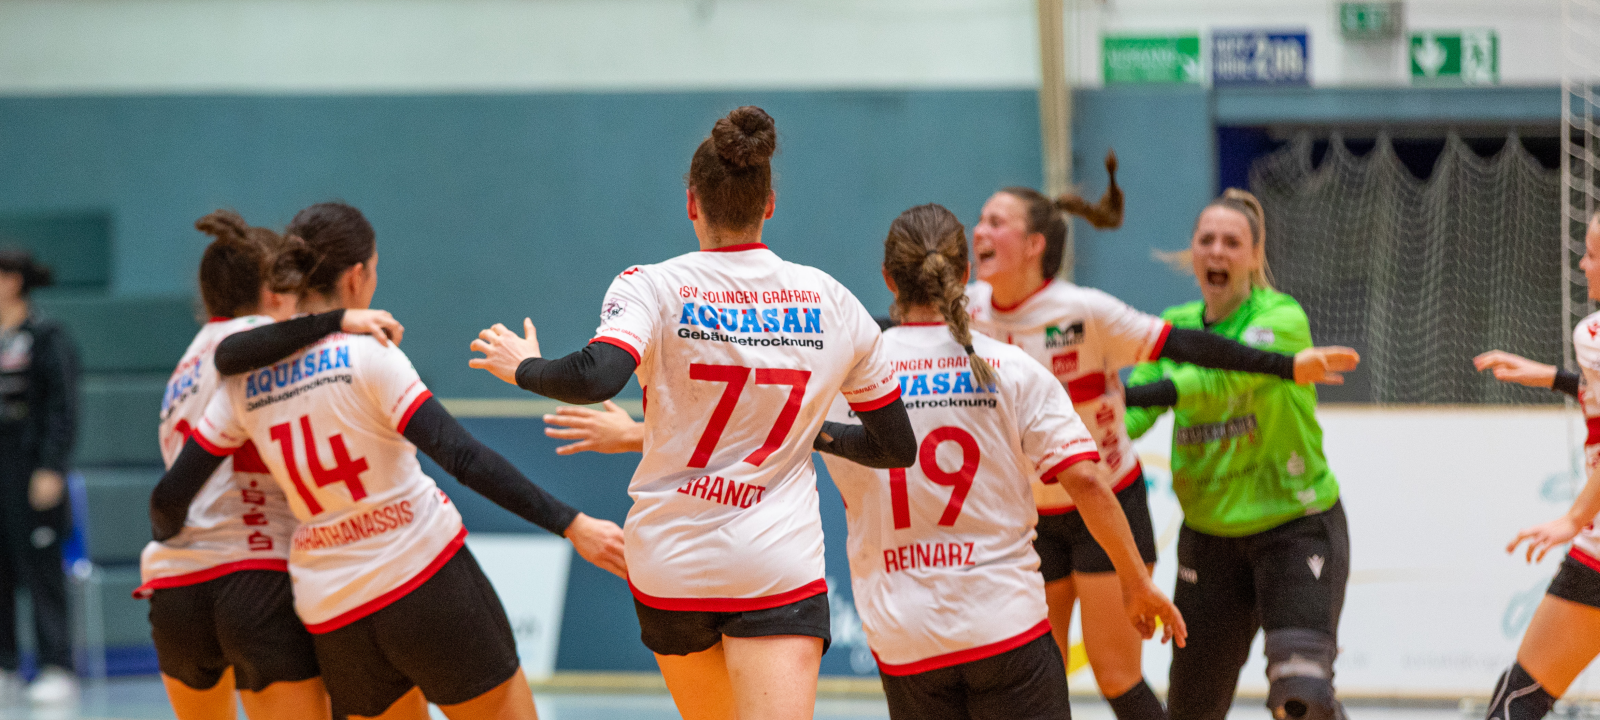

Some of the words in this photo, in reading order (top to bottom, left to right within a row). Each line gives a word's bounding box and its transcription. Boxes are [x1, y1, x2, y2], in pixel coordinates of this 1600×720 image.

[677, 328, 824, 350] Gebäudetrocknung
[269, 414, 369, 516] 14
[687, 364, 811, 468] 77
[888, 426, 980, 530] 19
[884, 542, 976, 574] REINARZ
